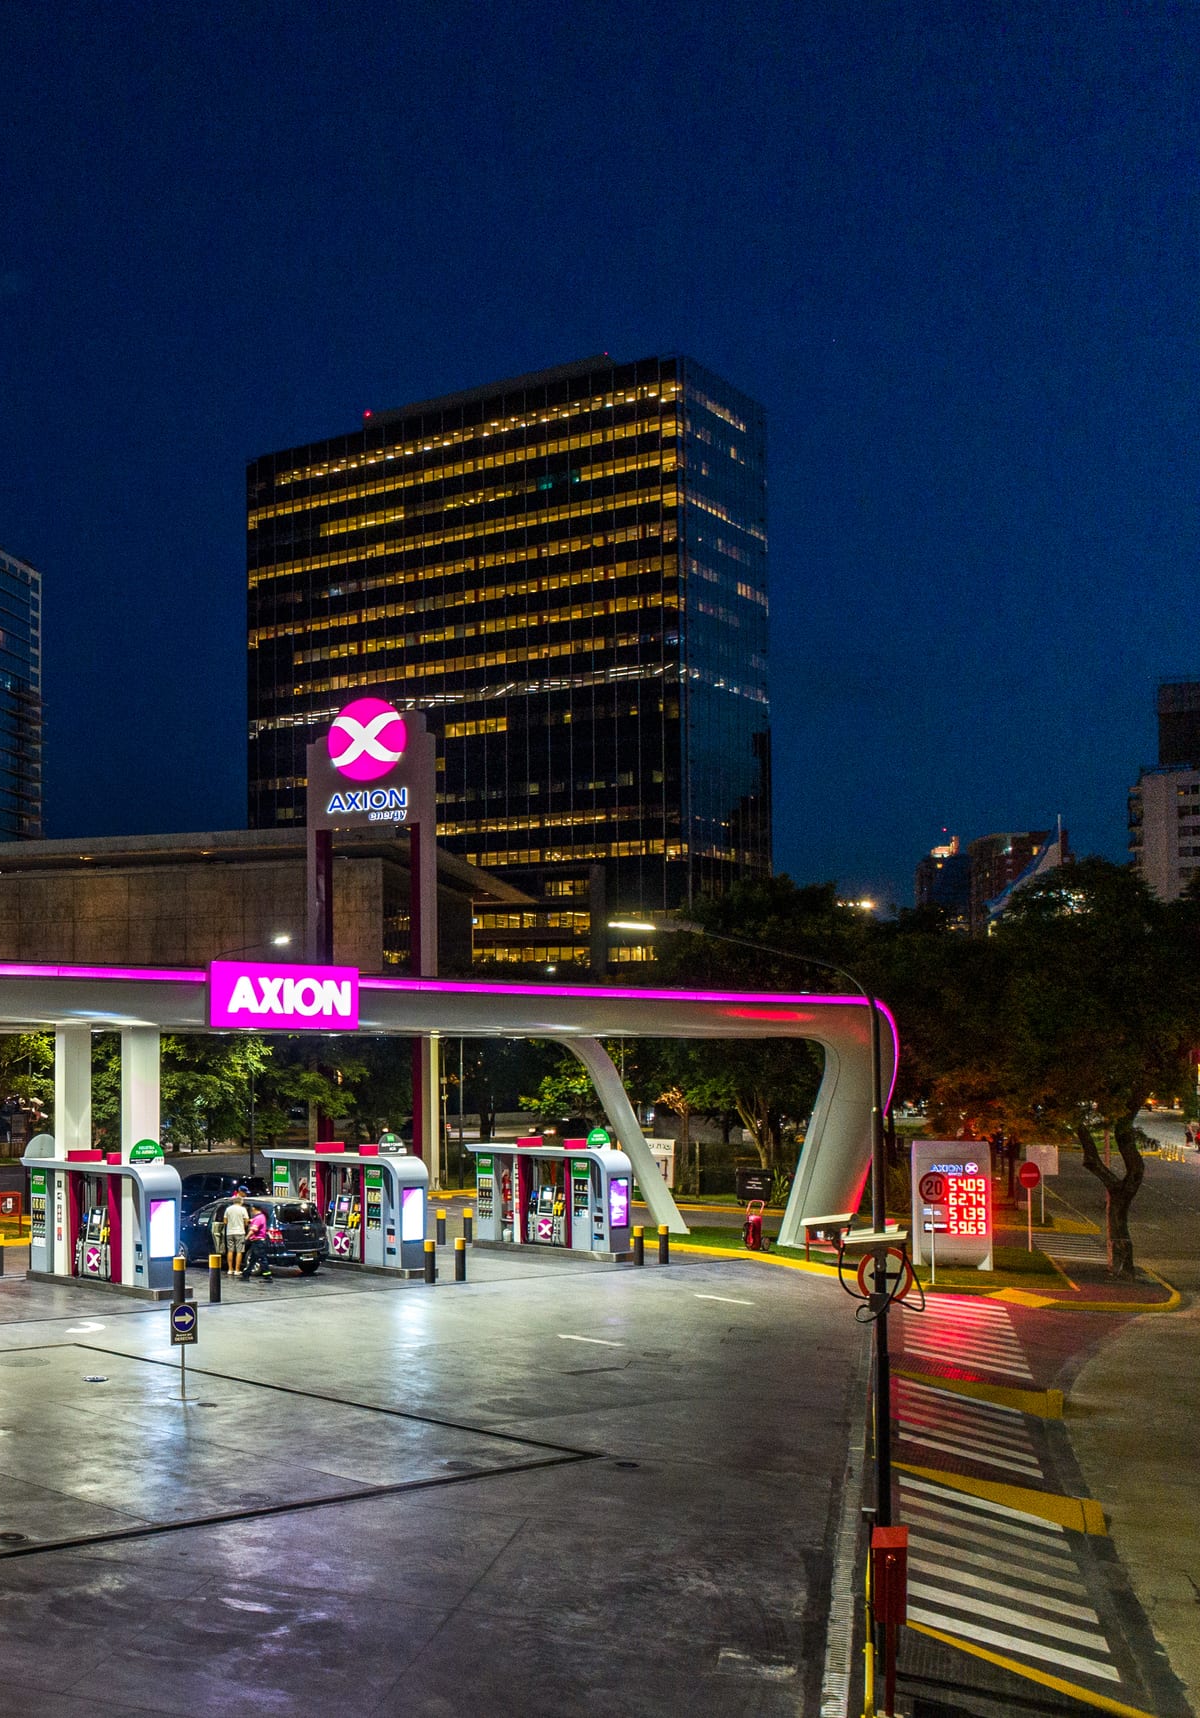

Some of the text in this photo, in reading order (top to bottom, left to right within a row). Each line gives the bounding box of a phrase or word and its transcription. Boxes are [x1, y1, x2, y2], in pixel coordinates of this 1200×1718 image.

[327, 787, 408, 814] AXION
[368, 809, 407, 821] energy
[227, 976, 352, 1016] AXION
[930, 1164, 963, 1172] AXION
[925, 1180, 943, 1196] 20
